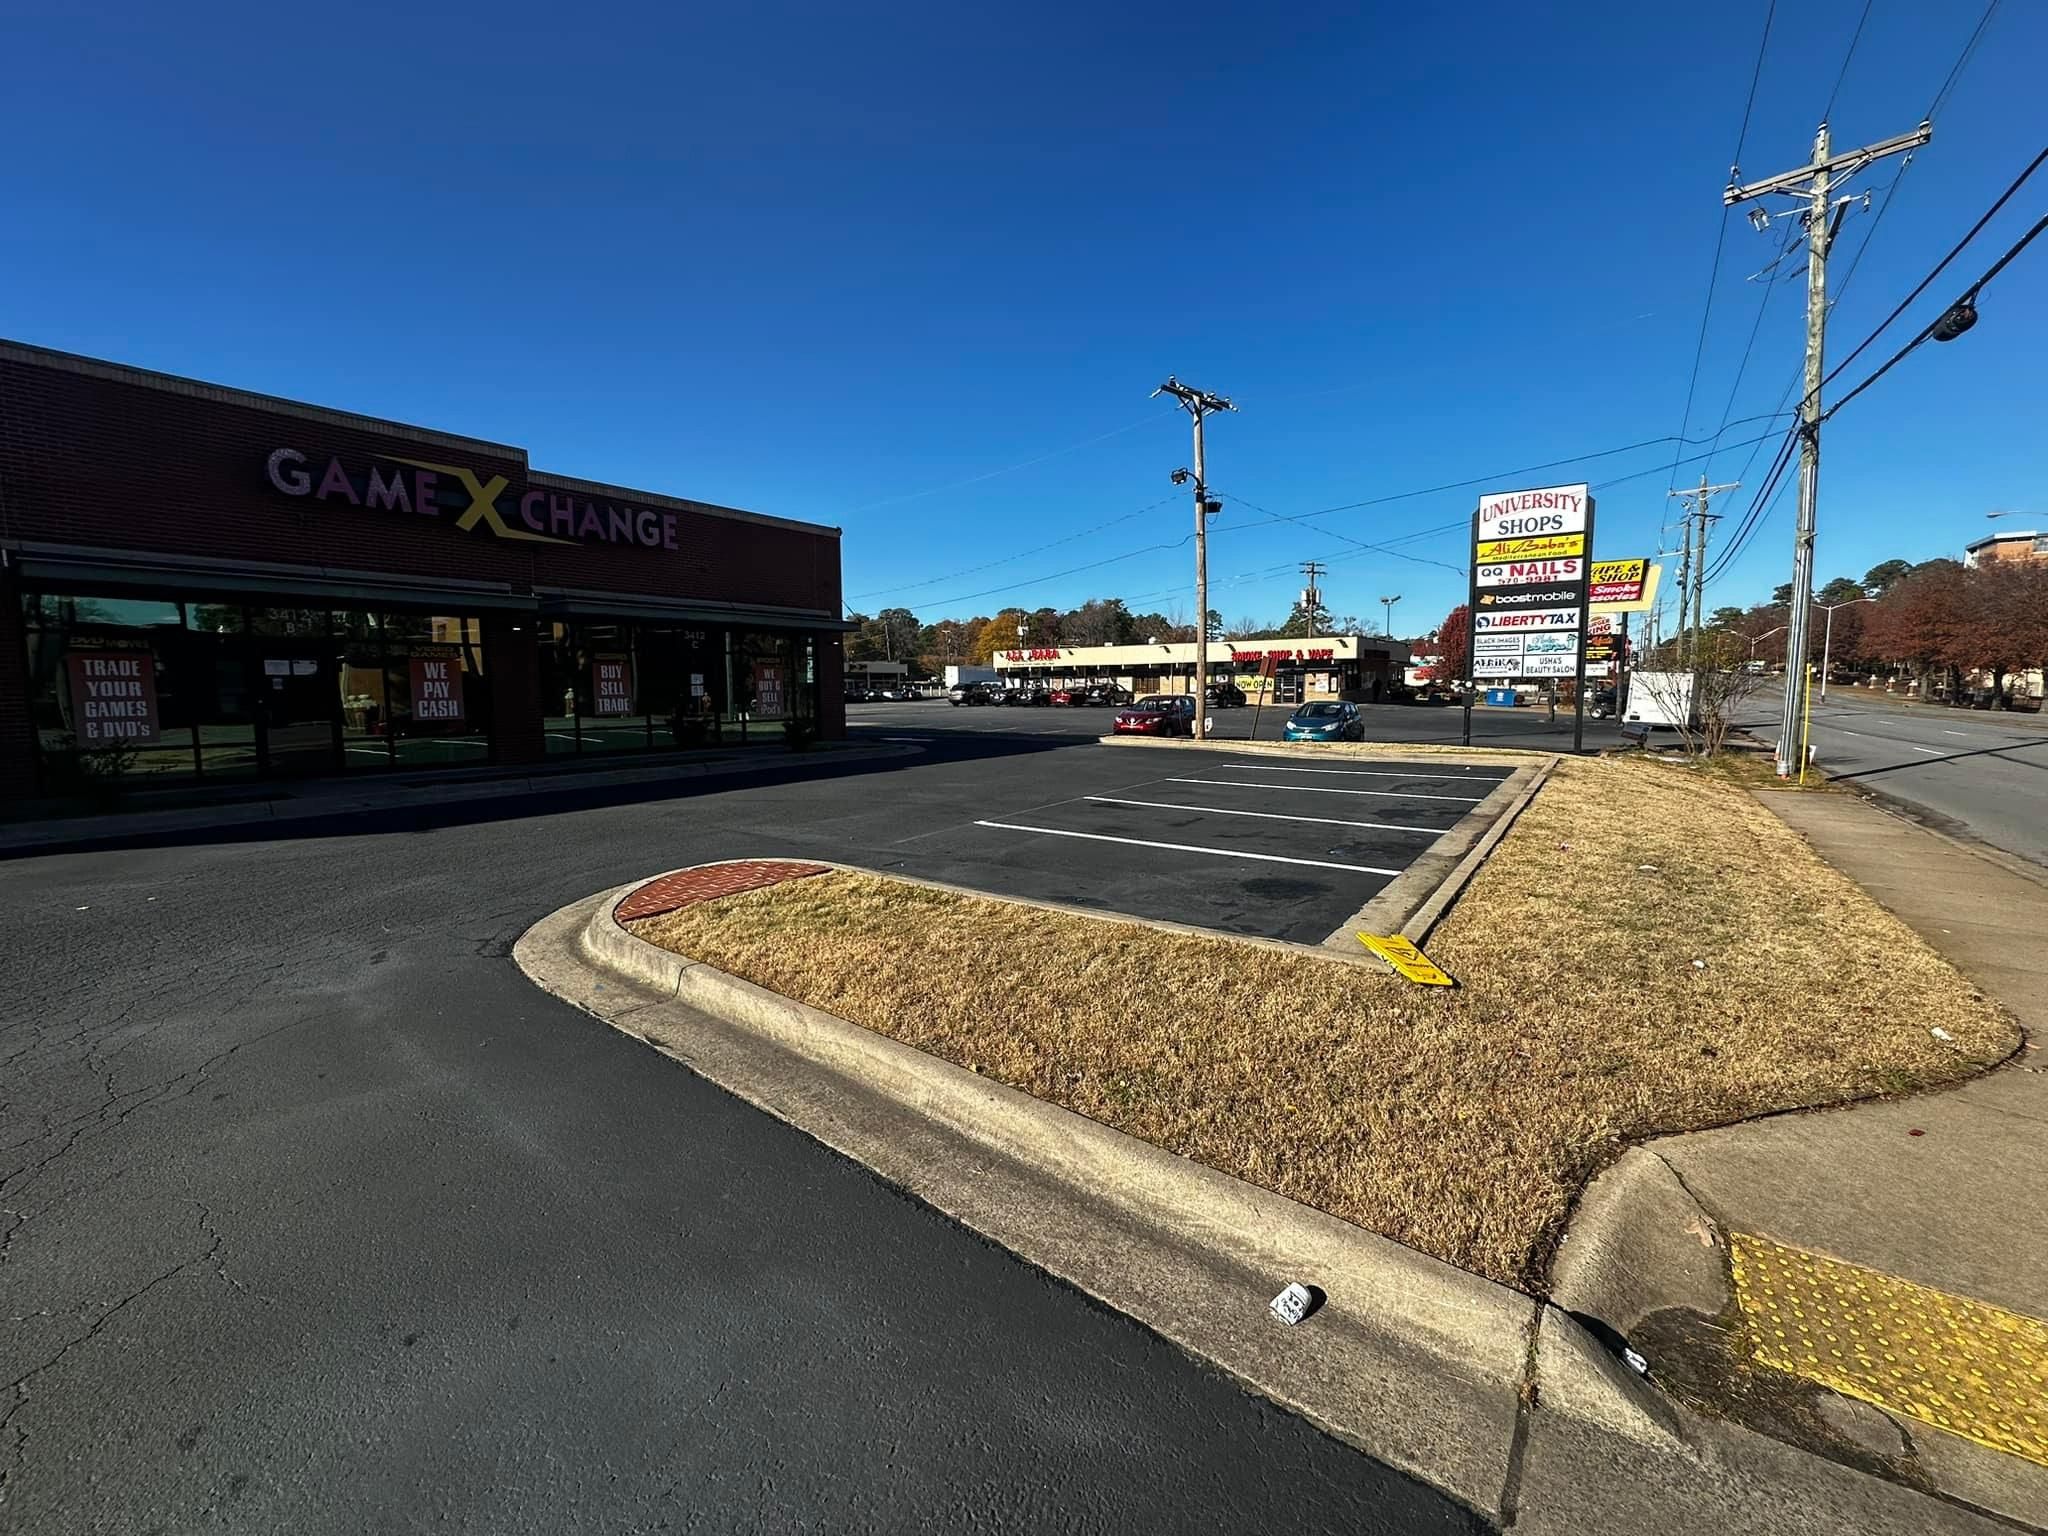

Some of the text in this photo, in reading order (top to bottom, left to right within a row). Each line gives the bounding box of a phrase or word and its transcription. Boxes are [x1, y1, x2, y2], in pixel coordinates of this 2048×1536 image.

[267, 447, 440, 516] GAME
[520, 489, 680, 551] CHANGE
[1483, 493, 1582, 522] UNIVERSITY
[1498, 515, 1563, 535] SHOPS
[1481, 537, 1580, 557] Ali Baba's
[1481, 560, 1577, 577] QQ NAILS
[1628, 564, 1641, 572] &
[1598, 573, 1640, 582] SHOP
[1594, 584, 1641, 594] Smoke
[1589, 619, 1610, 628] URGER
[1231, 651, 1262, 661] SMOKE
[1267, 650, 1293, 660] SHOP
[1308, 649, 1334, 660] VAPE
[82, 659, 141, 676] TRADE
[424, 661, 448, 680] WE
[600, 664, 622, 679] BUY
[1526, 665, 1575, 674] BEAUTY SALON
[86, 681, 142, 697] YOUR
[424, 681, 450, 698] PAY
[600, 680, 625, 696] SELL
[1236, 681, 1253, 689] NOW
[85, 700, 148, 718] GAMES
[418, 699, 459, 717] CASH
[598, 697, 630, 713] TRADE
[102, 721, 150, 738] DVD's
